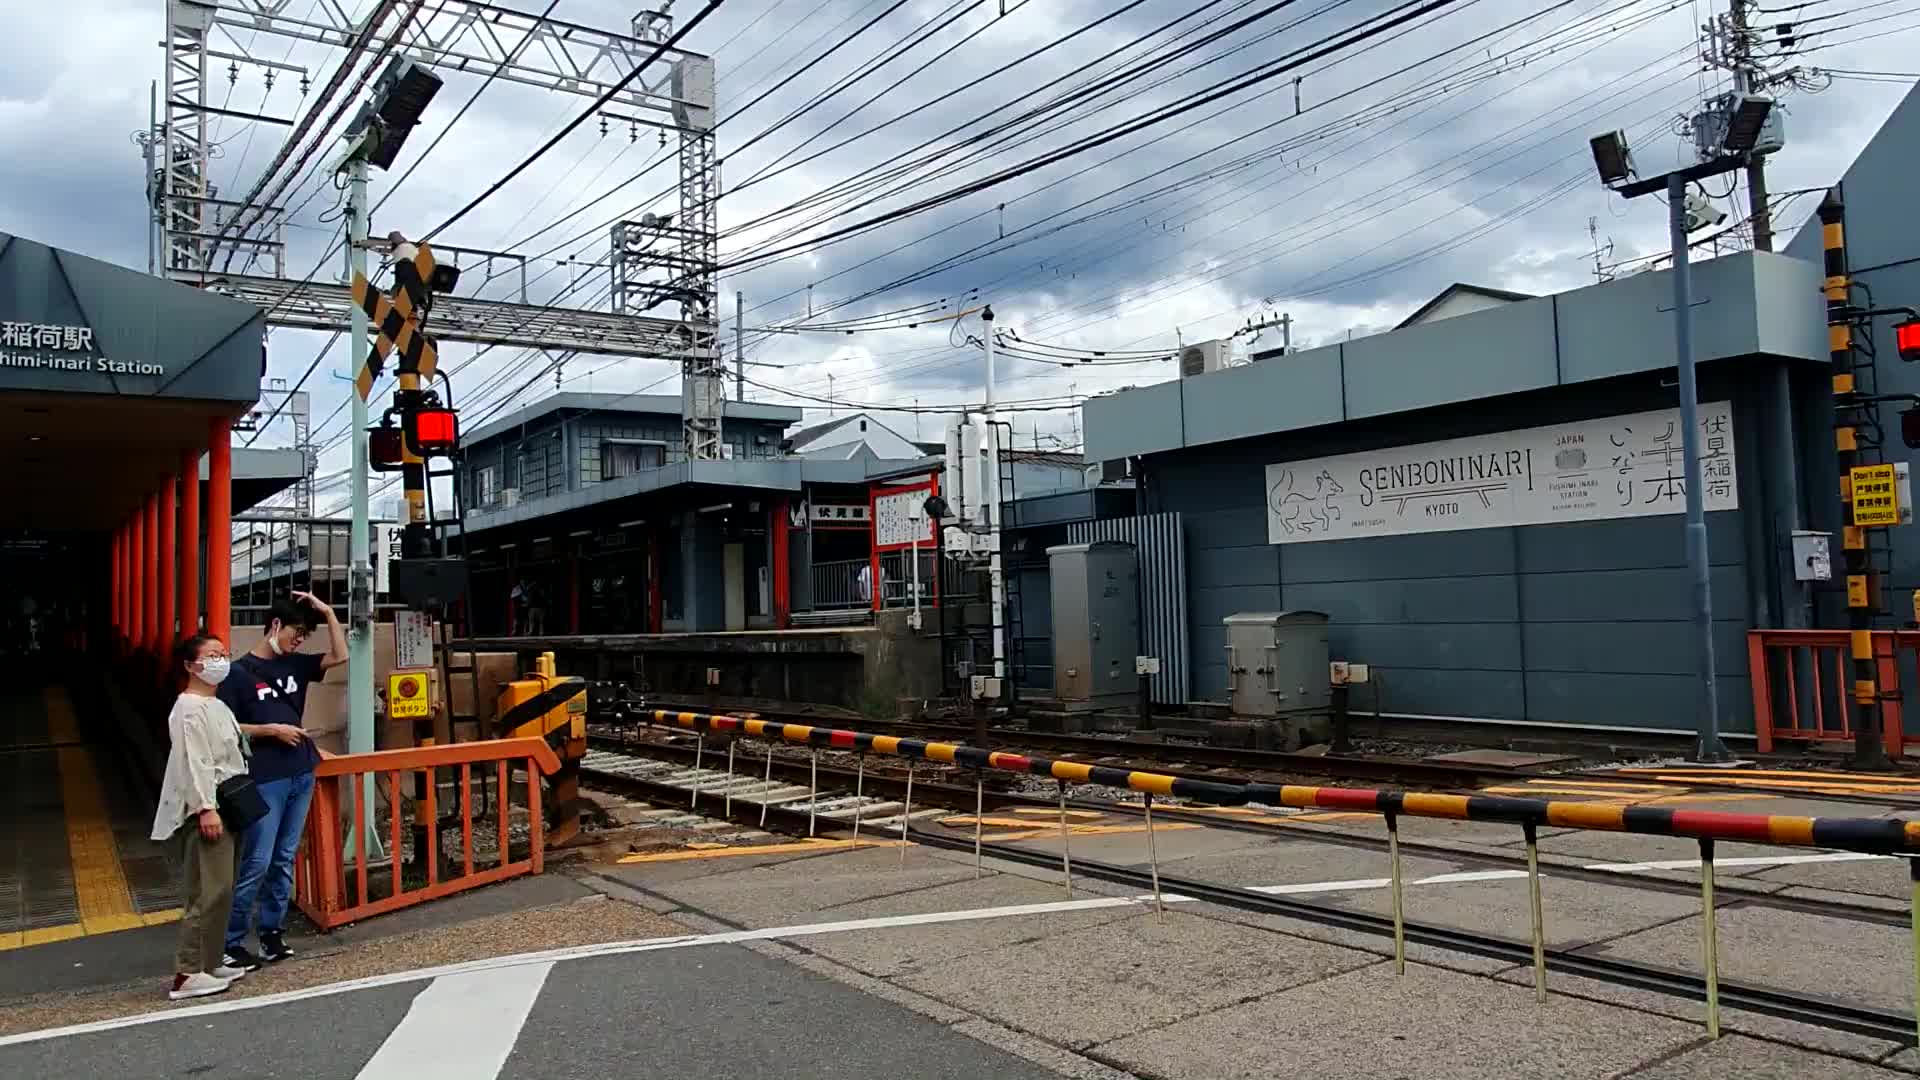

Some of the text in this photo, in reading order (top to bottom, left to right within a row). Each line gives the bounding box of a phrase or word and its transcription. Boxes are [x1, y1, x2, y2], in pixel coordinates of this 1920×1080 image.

[0, 321, 93, 351] 稲荷駅
[97, 357, 164, 375] Station
[1554, 433, 1584, 447] JAPAN
[1609, 426, 1635, 507] いなり
[1700, 415, 1731, 498] 伏見稲荷
[1359, 448, 1534, 507] SENBONINARI
[1425, 503, 1459, 517] KYOTO
